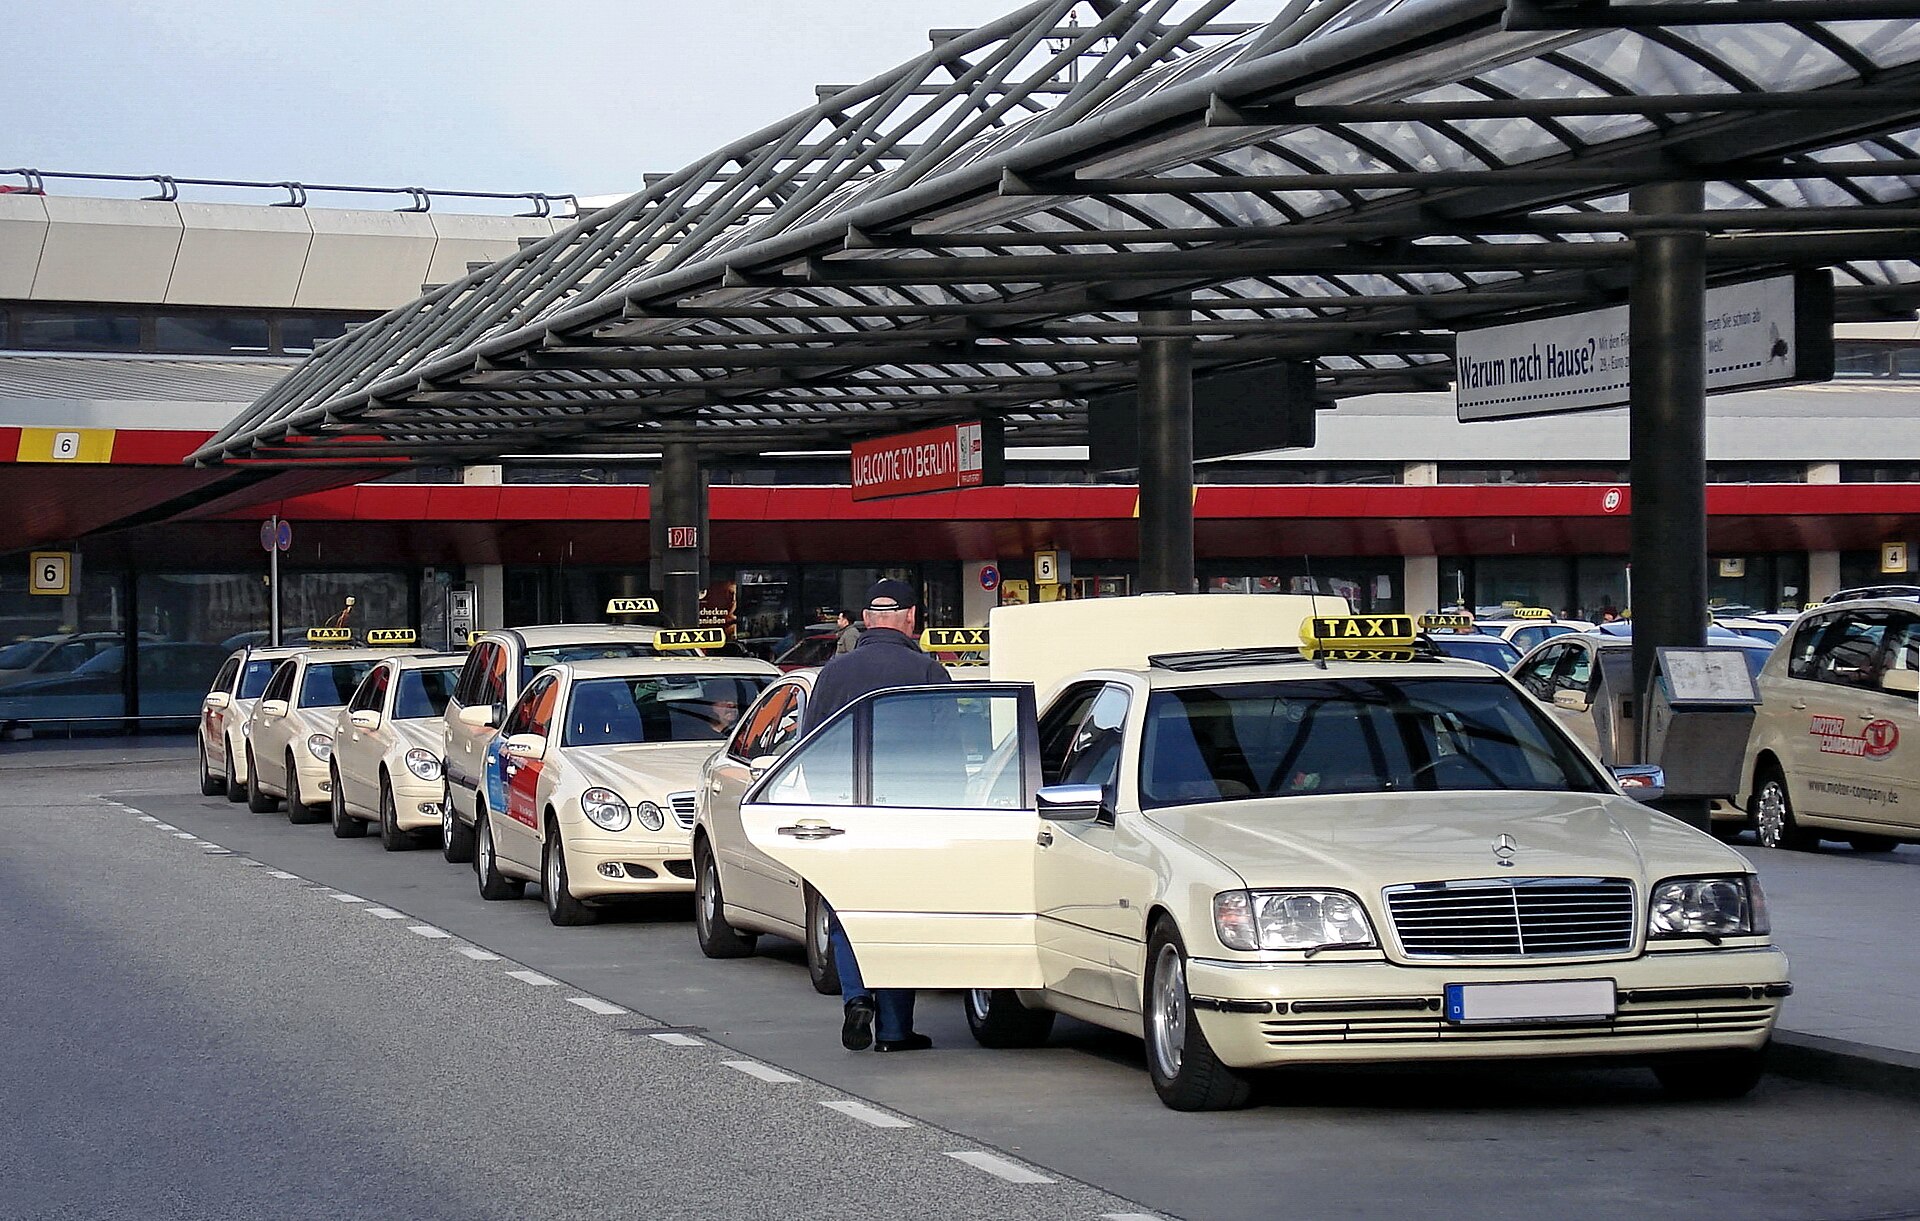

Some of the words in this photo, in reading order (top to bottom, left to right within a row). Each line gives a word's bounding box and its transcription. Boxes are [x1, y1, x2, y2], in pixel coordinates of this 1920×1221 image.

[1460, 356, 1505, 389] Warum
[1511, 343, 1542, 382] nach
[1547, 338, 1596, 378] Hause?
[61, 438, 71, 453] 6
[853, 449, 900, 487] WELCOME
[901, 447, 914, 479] TO
[916, 441, 956, 478] BERLIN!
[1890, 551, 1898, 563] 4
[43, 564, 57, 582] 6
[1042, 561, 1050, 575] 5
[616, 600, 652, 610] TAXI
[1429, 616, 1465, 625] TAXI
[315, 630, 345, 638] TAXI
[1324, 619, 1399, 637] TAXI
[377, 631, 410, 640] TAXI
[667, 631, 715, 643] TAXI
[937, 630, 984, 644] TAX
[1821, 736, 1865, 755] COMPANY
[1453, 1005, 1461, 1014] D
